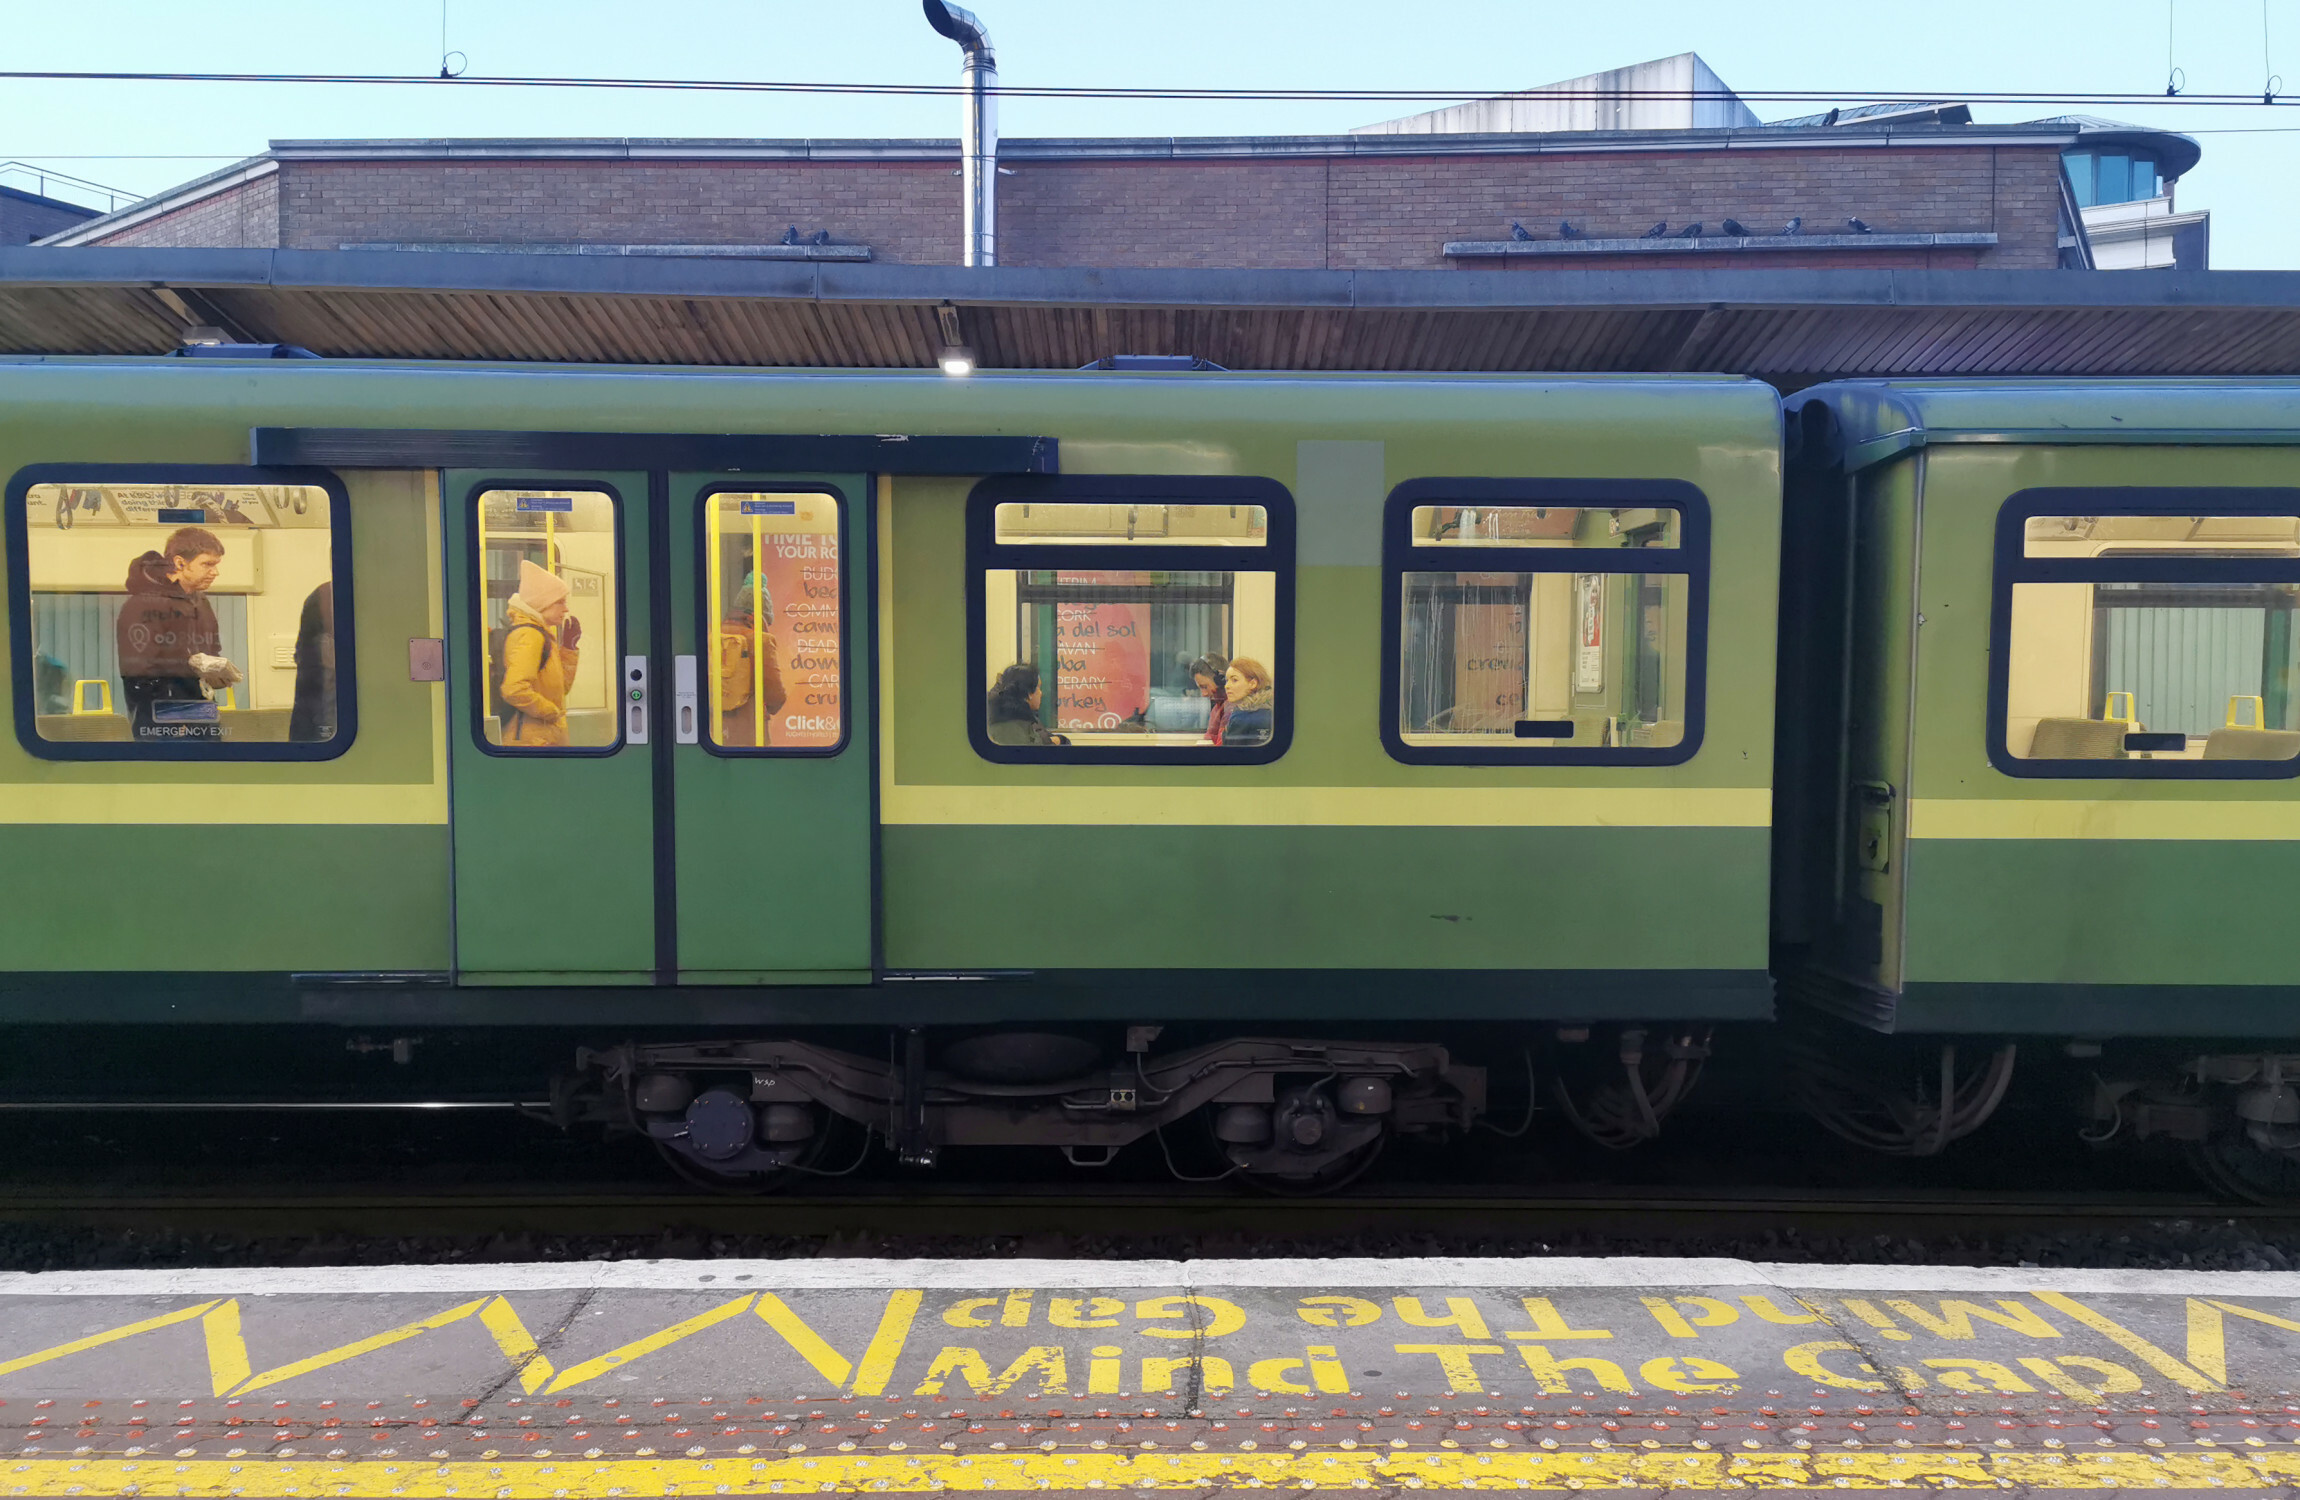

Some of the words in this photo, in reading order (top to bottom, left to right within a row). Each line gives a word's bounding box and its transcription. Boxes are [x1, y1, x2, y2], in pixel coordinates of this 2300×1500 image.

[776, 546, 817, 559] YOUR
[1072, 621, 1100, 638] del
[1106, 621, 1137, 638] sol
[797, 639, 837, 653] DEAD
[1057, 641, 1096, 655] AVAN
[785, 716, 840, 730] Click&
[139, 726, 208, 737] EMERGENCY
[210, 726, 233, 737] EXIT
[942, 1288, 1248, 1339] Gap
[1296, 1295, 1615, 1340] The
[1639, 1295, 2063, 1341] Mind
[912, 1345, 1351, 1396] Mind
[1393, 1343, 1742, 1395] The
[1783, 1340, 2143, 1406] Gap
